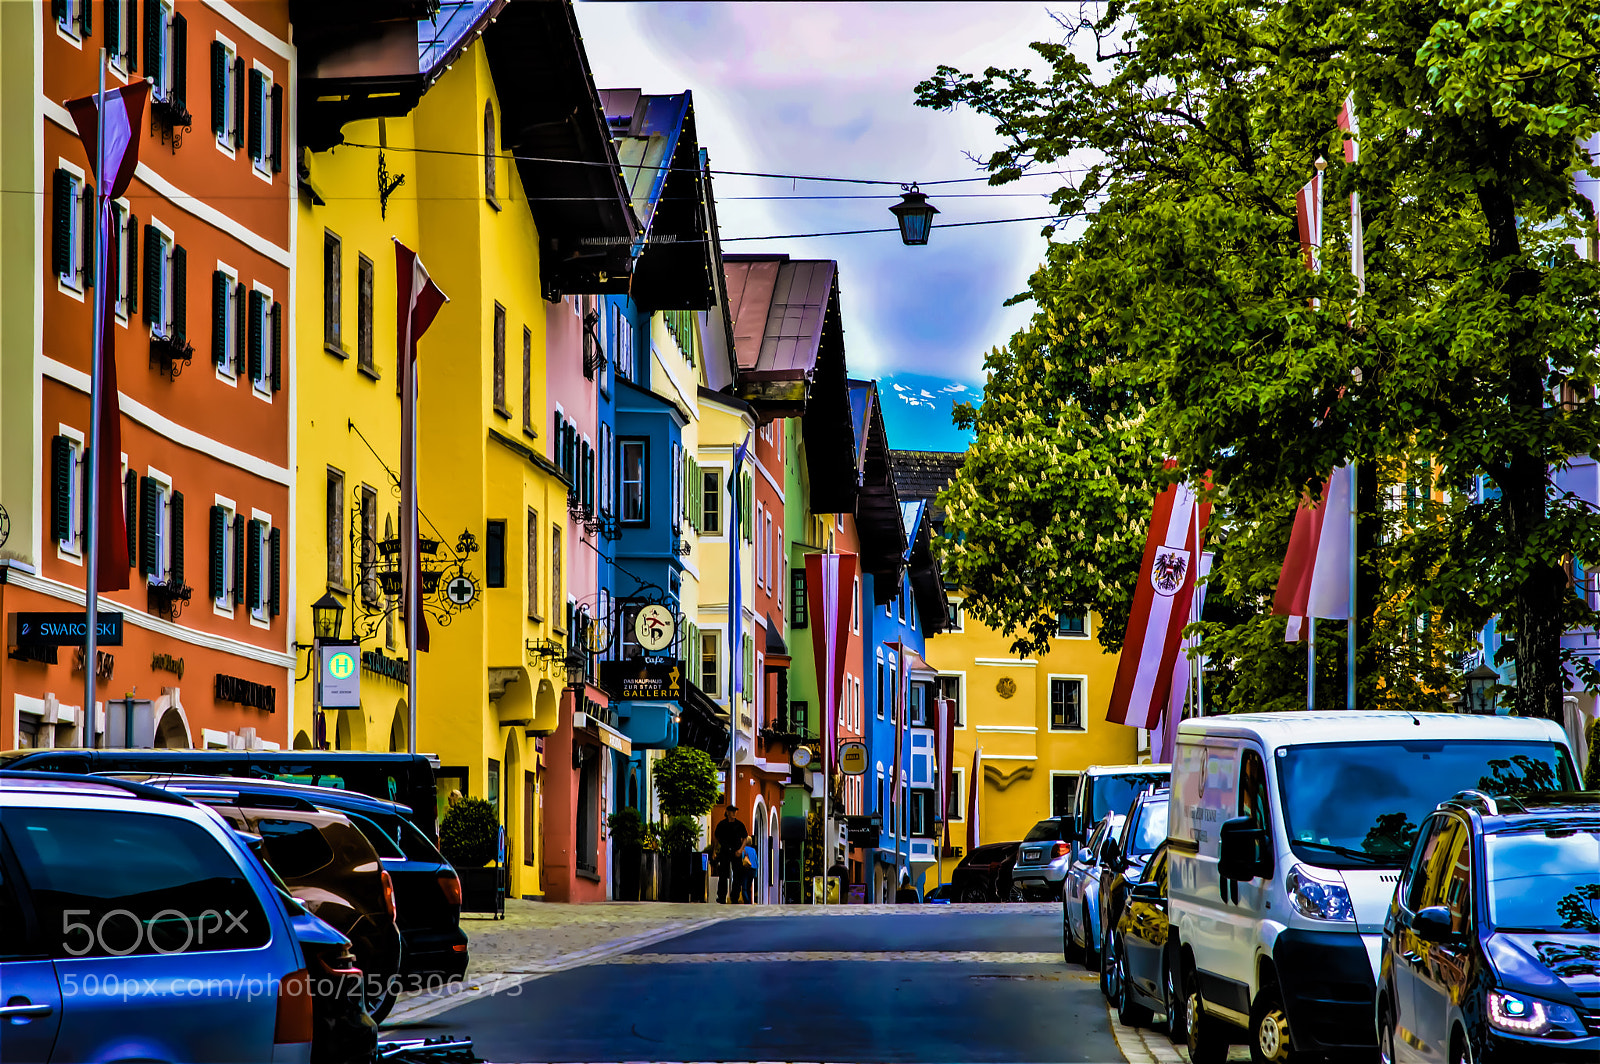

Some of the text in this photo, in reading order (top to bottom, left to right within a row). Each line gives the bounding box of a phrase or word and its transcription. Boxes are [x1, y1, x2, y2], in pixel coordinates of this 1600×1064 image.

[40, 622, 116, 636] SWAROSKI
[335, 658, 349, 674] H
[623, 689, 680, 697] GALLERIA
